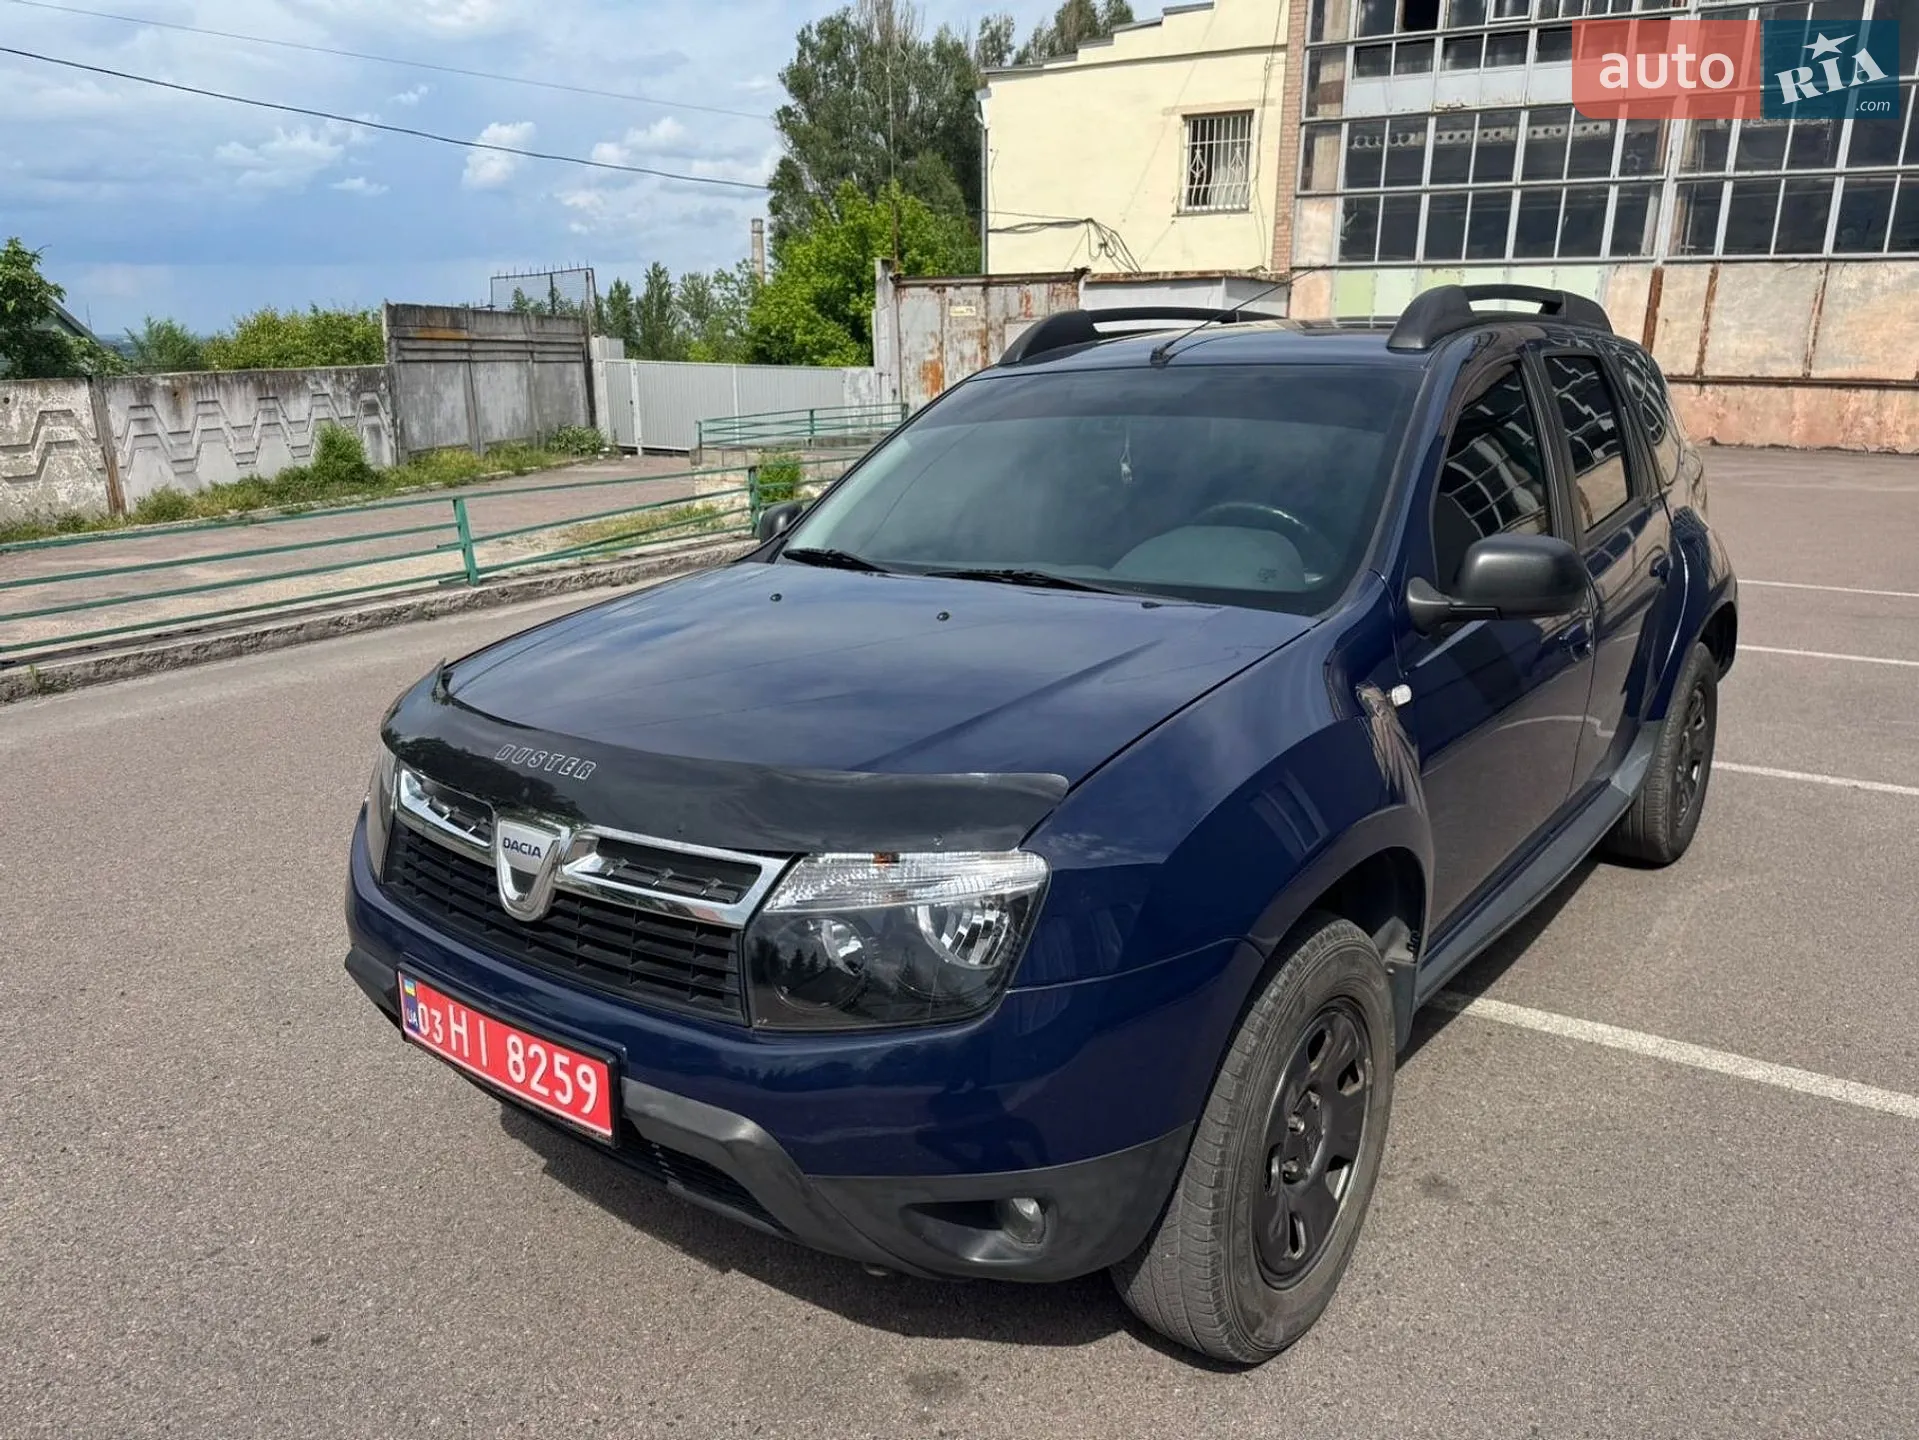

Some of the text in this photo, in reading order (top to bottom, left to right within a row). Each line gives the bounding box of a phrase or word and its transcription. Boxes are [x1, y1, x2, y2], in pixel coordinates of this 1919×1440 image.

[494, 743, 598, 780] DUSTER
[502, 837, 543, 859] DACIA
[506, 1034, 598, 1114] 8259
